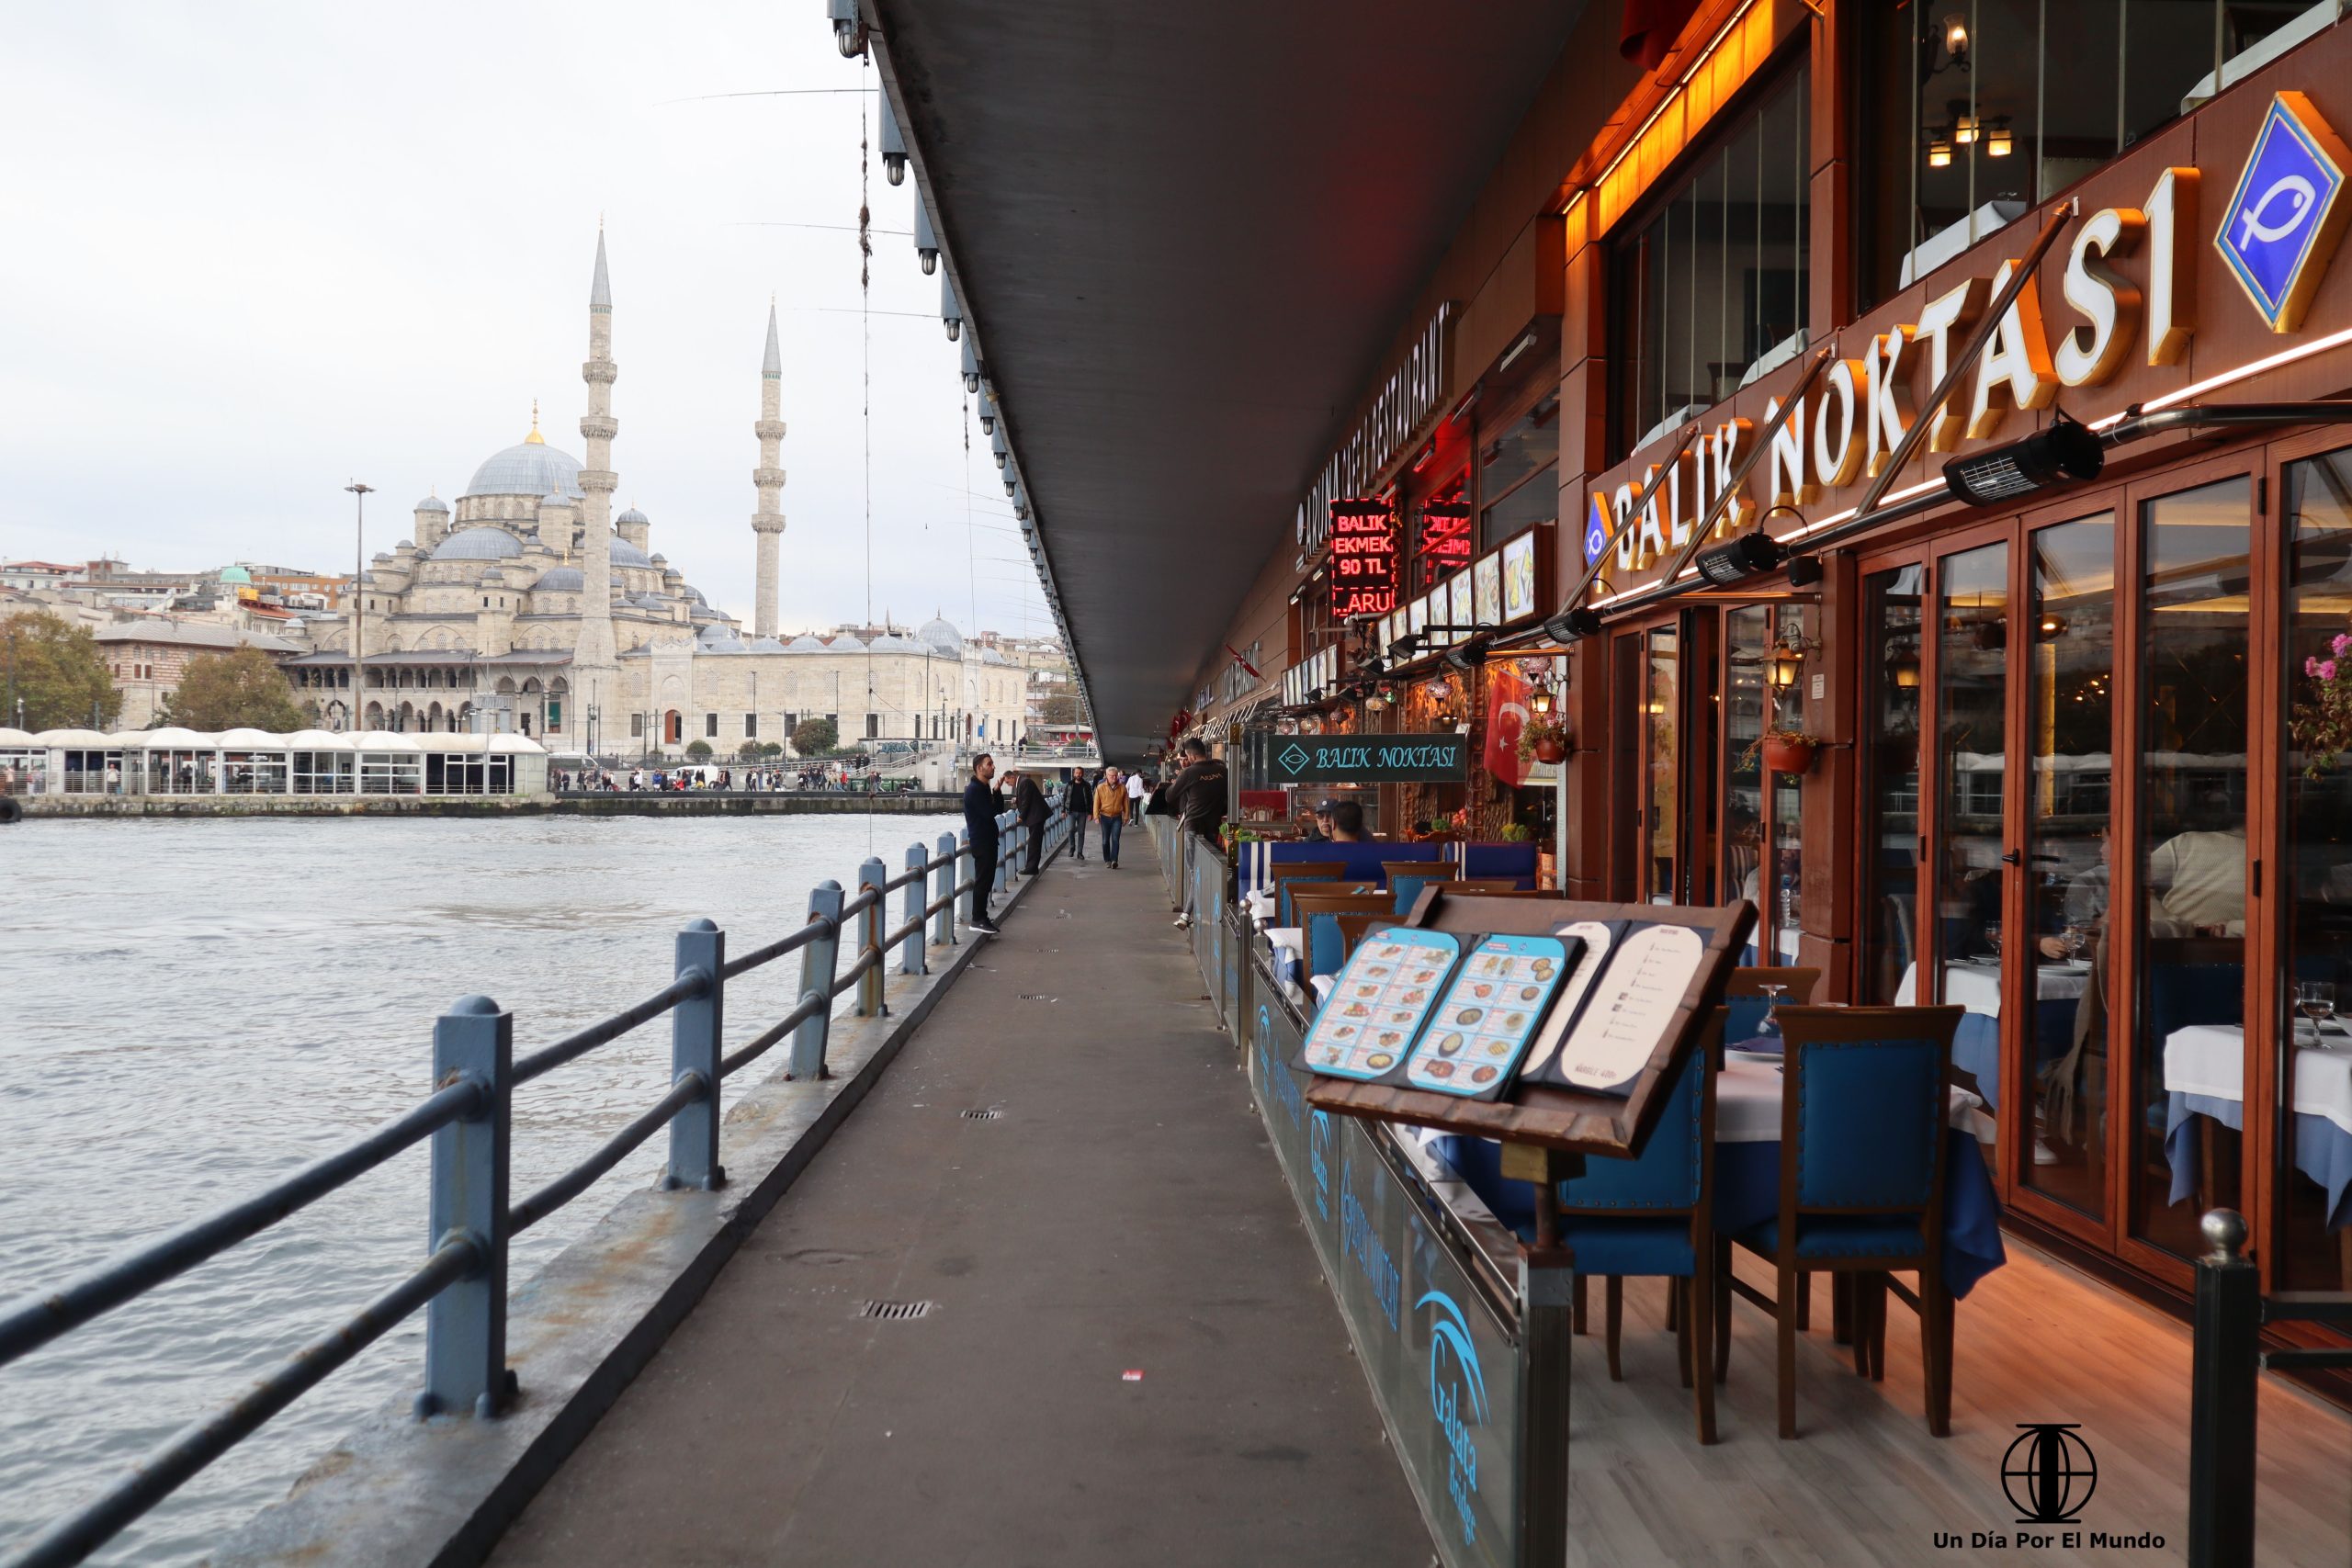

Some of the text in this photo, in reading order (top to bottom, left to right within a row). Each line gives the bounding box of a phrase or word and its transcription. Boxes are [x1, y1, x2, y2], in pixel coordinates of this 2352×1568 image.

[1370, 300, 1445, 478] RESTAURANT
[1612, 166, 2177, 570] BALIK NOKTASI
[1335, 536, 1392, 554] EKMEK
[1338, 514, 1387, 533] BALIK
[1340, 558, 1386, 575] 90 TL
[1316, 744, 1457, 769] BALIK NOKTASI
[1430, 1332, 1476, 1493] Galata
[1449, 1452, 1476, 1547] Bridge
